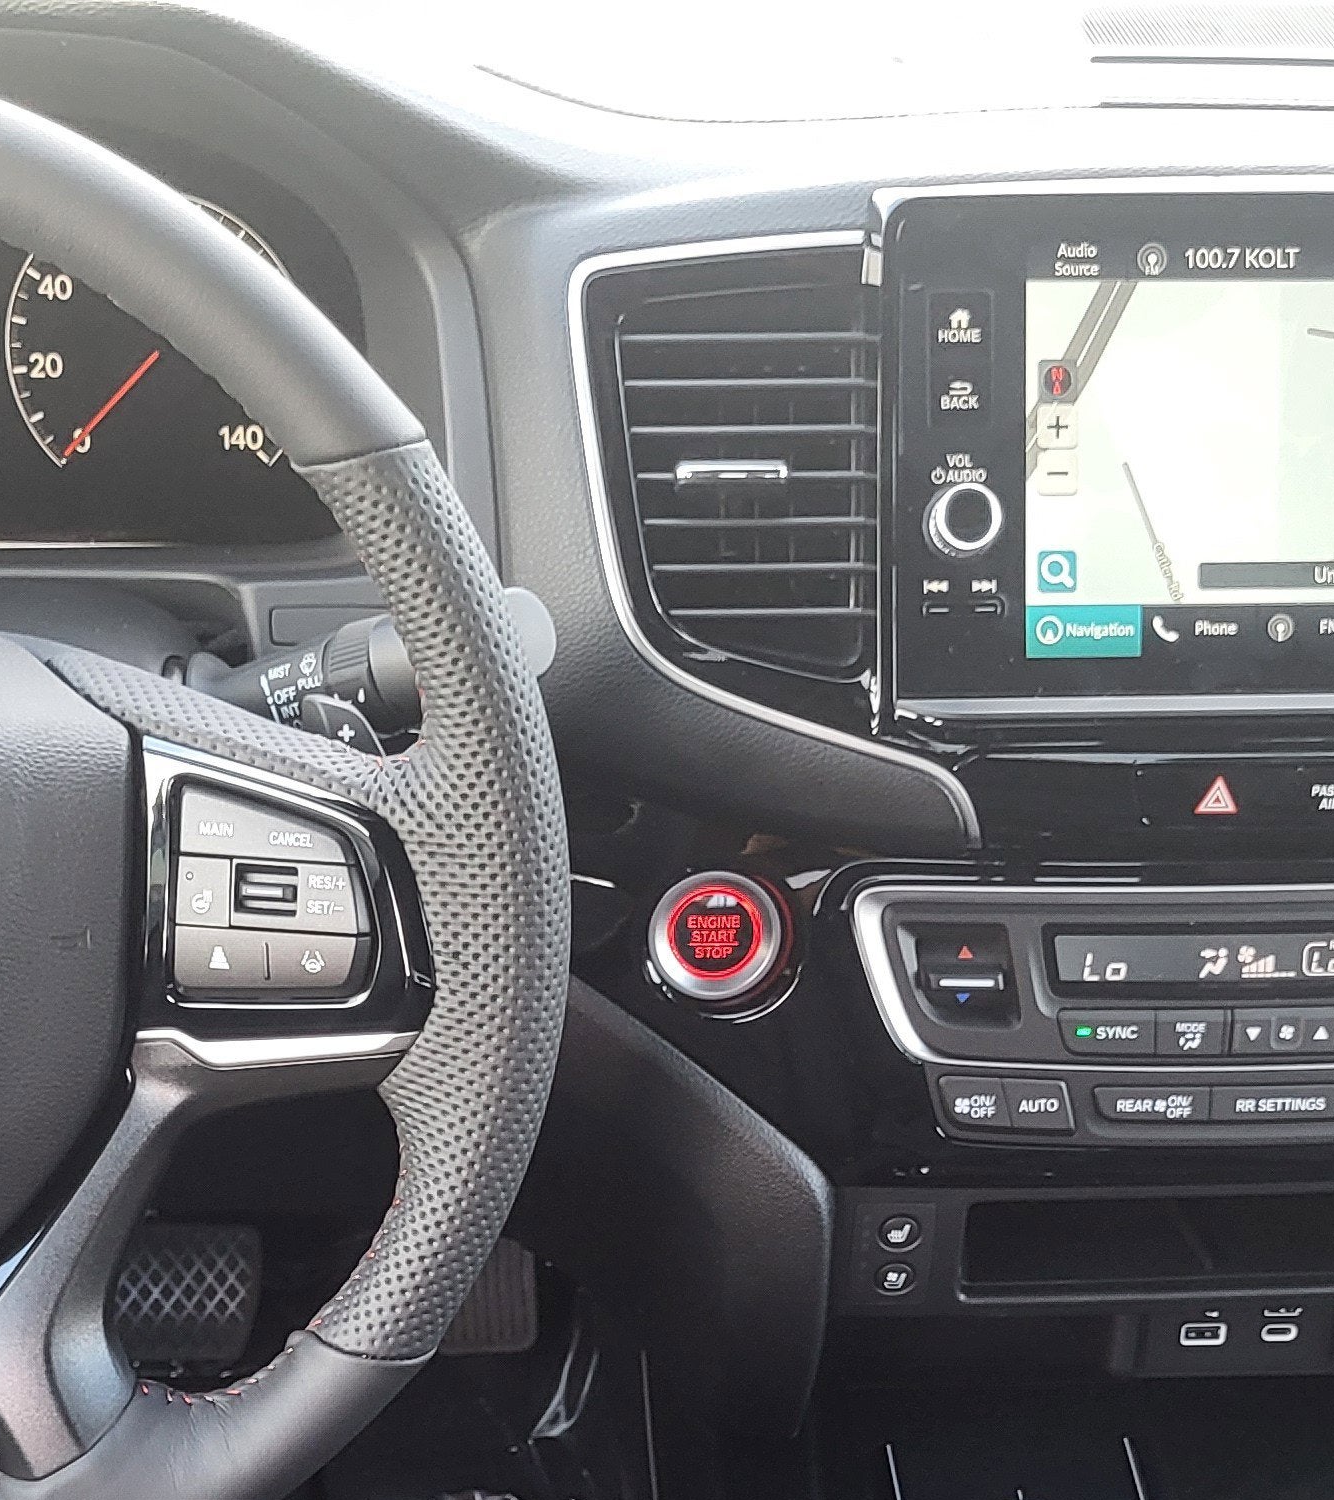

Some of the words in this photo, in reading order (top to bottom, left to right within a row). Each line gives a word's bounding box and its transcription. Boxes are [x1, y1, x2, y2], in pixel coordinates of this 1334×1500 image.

[1056, 241, 1098, 258] Audio
[1184, 248, 1240, 269] 100.7
[1244, 247, 1300, 269] KOLT
[1054, 262, 1100, 277] Source
[37, 274, 73, 301] 40
[937, 328, 982, 344] HOME
[28, 353, 63, 379] 20
[940, 395, 979, 410] BACK
[71, 428, 91, 453] 0
[218, 424, 264, 451] 140
[946, 453, 974, 469] VOL
[946, 468, 987, 483] AUDIO
[1066, 621, 1134, 639] Navigation
[1194, 619, 1238, 637] Phone
[297, 675, 321, 690] PULL
[274, 686, 296, 704] OFF
[198, 821, 234, 838] MAIN
[269, 831, 313, 848] CANCEL
[687, 915, 741, 930] ENGINE
[691, 929, 737, 944] START
[694, 945, 732, 960] STOP
[1082, 952, 1128, 982] Lo
[1096, 1025, 1138, 1041] SYNC
[1175, 1022, 1206, 1035] MODE
[1018, 1097, 1059, 1114] AUTO
[1116, 1099, 1152, 1113] REAR
[1235, 1099, 1255, 1113] RR
[1257, 1096, 1326, 1113] SETTINGS
[970, 1106, 996, 1120] OFF
[1166, 1106, 1192, 1120] OFF
